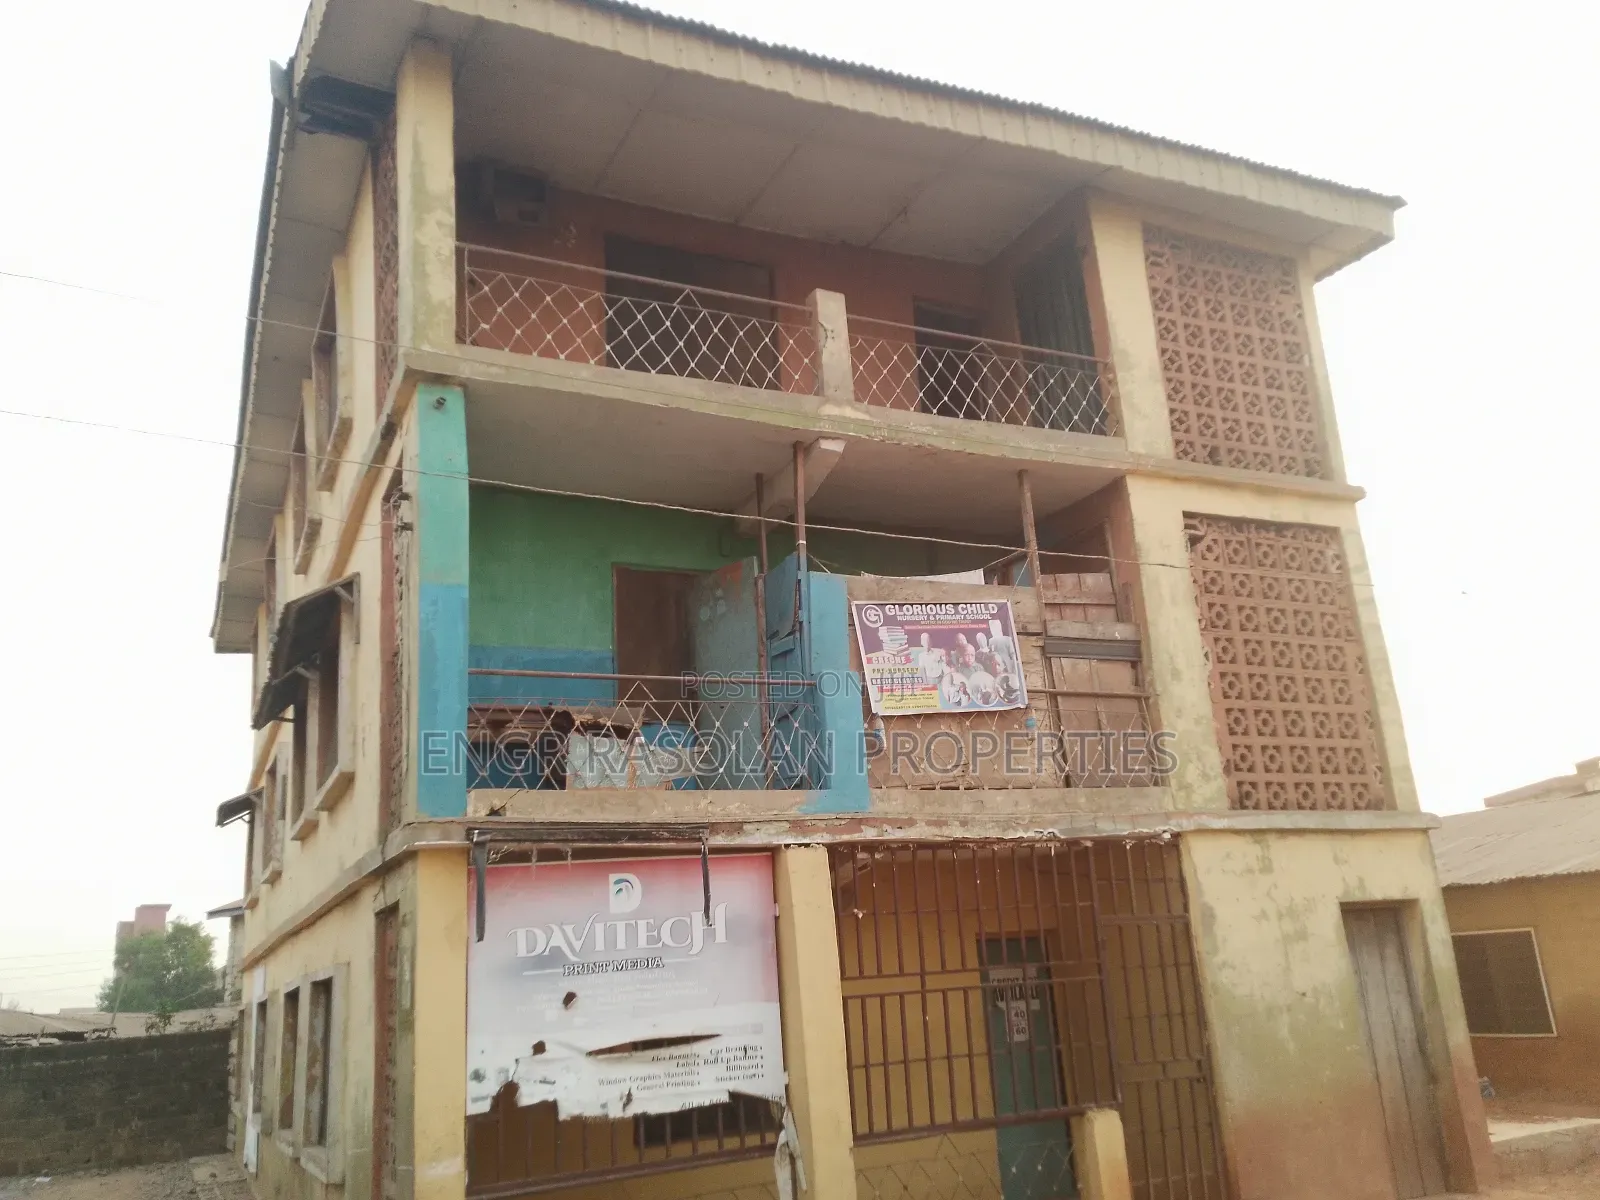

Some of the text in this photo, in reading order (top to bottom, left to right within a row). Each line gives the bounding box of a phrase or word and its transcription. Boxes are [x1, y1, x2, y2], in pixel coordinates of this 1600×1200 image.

[885, 603, 998, 616] GLORIOUS CHILD
[506, 902, 728, 962] DAVITECH
[562, 956, 665, 977] PRINT MEDIA
